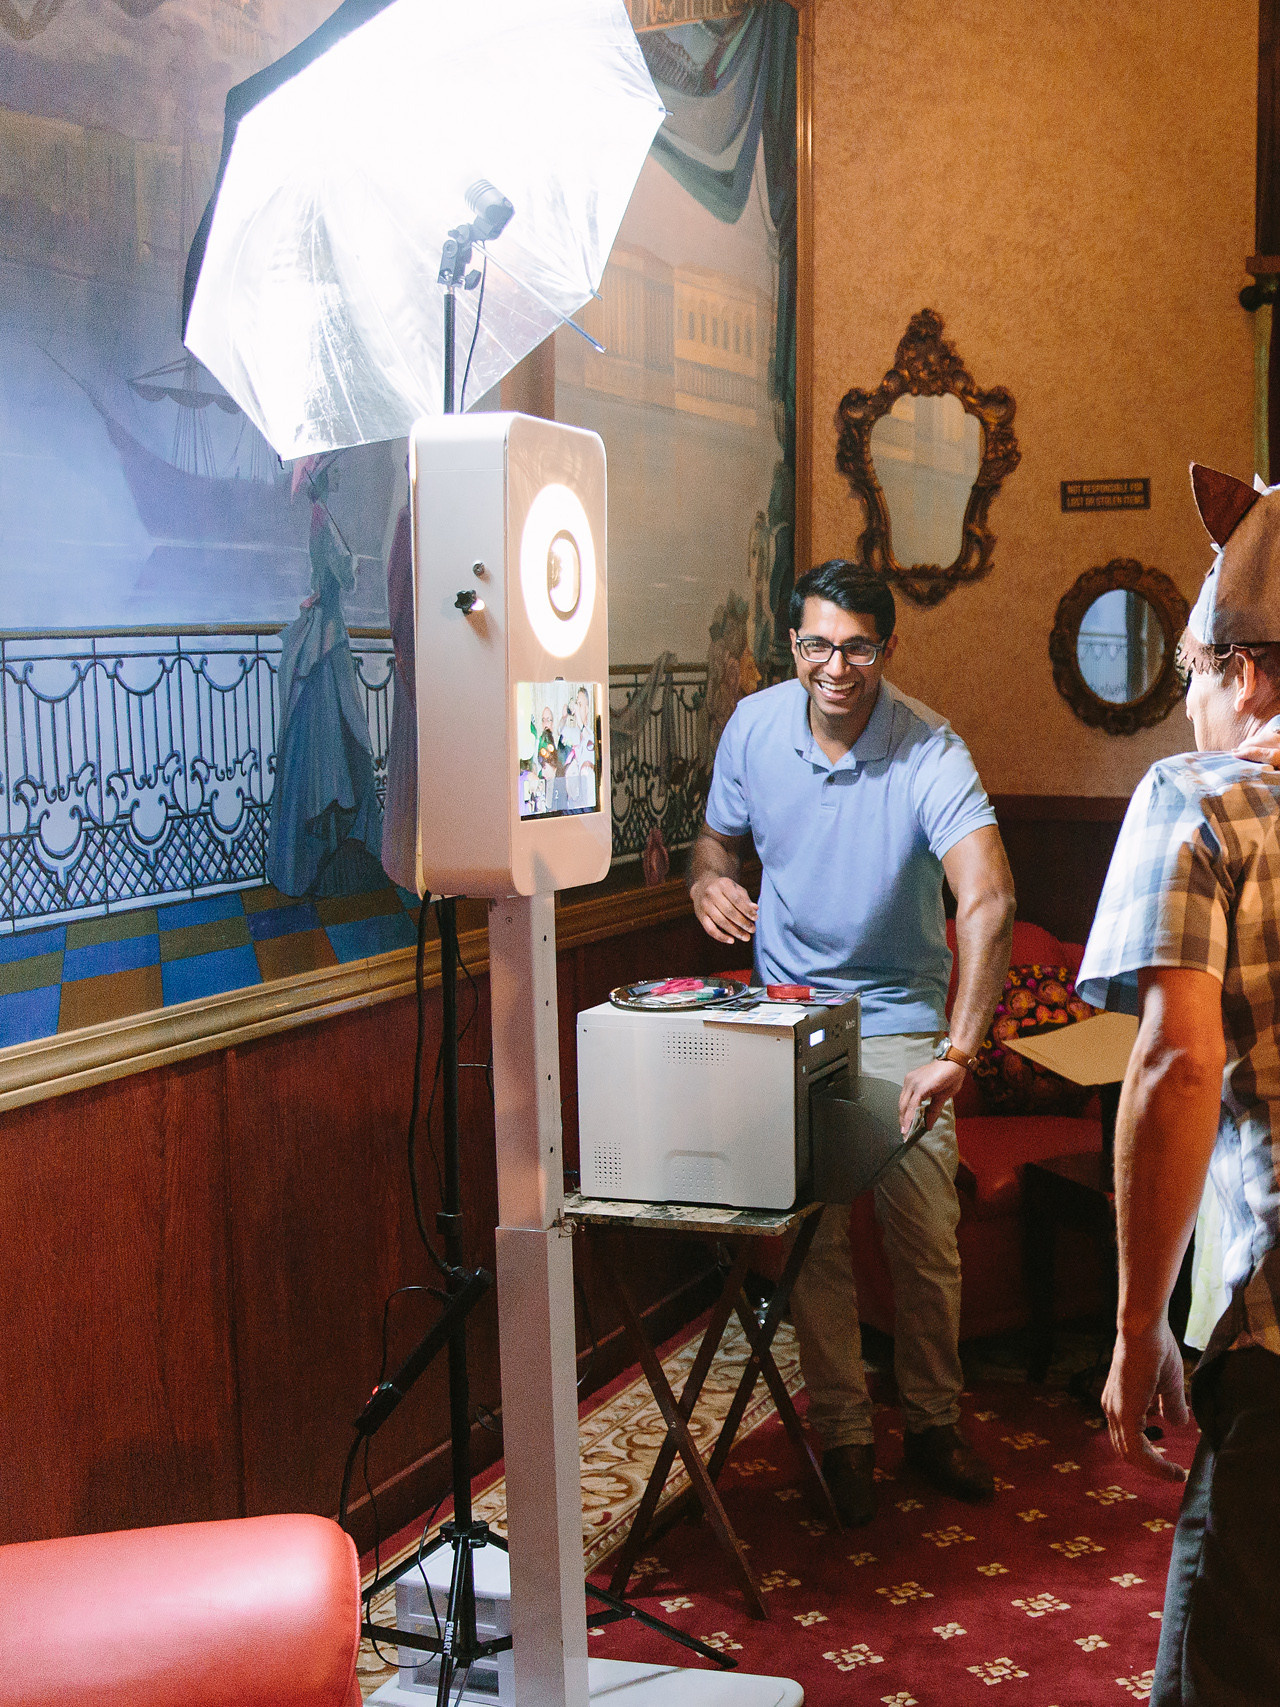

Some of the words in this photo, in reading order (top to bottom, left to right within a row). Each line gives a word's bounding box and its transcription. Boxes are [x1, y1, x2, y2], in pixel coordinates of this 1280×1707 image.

[1067, 484, 1081, 494] NOT
[1083, 483, 1128, 494] RESPONSIBLE
[1130, 482, 1144, 492] FOR
[1066, 497, 1083, 507] LOST
[1085, 496, 1095, 506] OR
[1096, 495, 1122, 506] STOLEN
[443, 1621, 454, 1655] EMART
